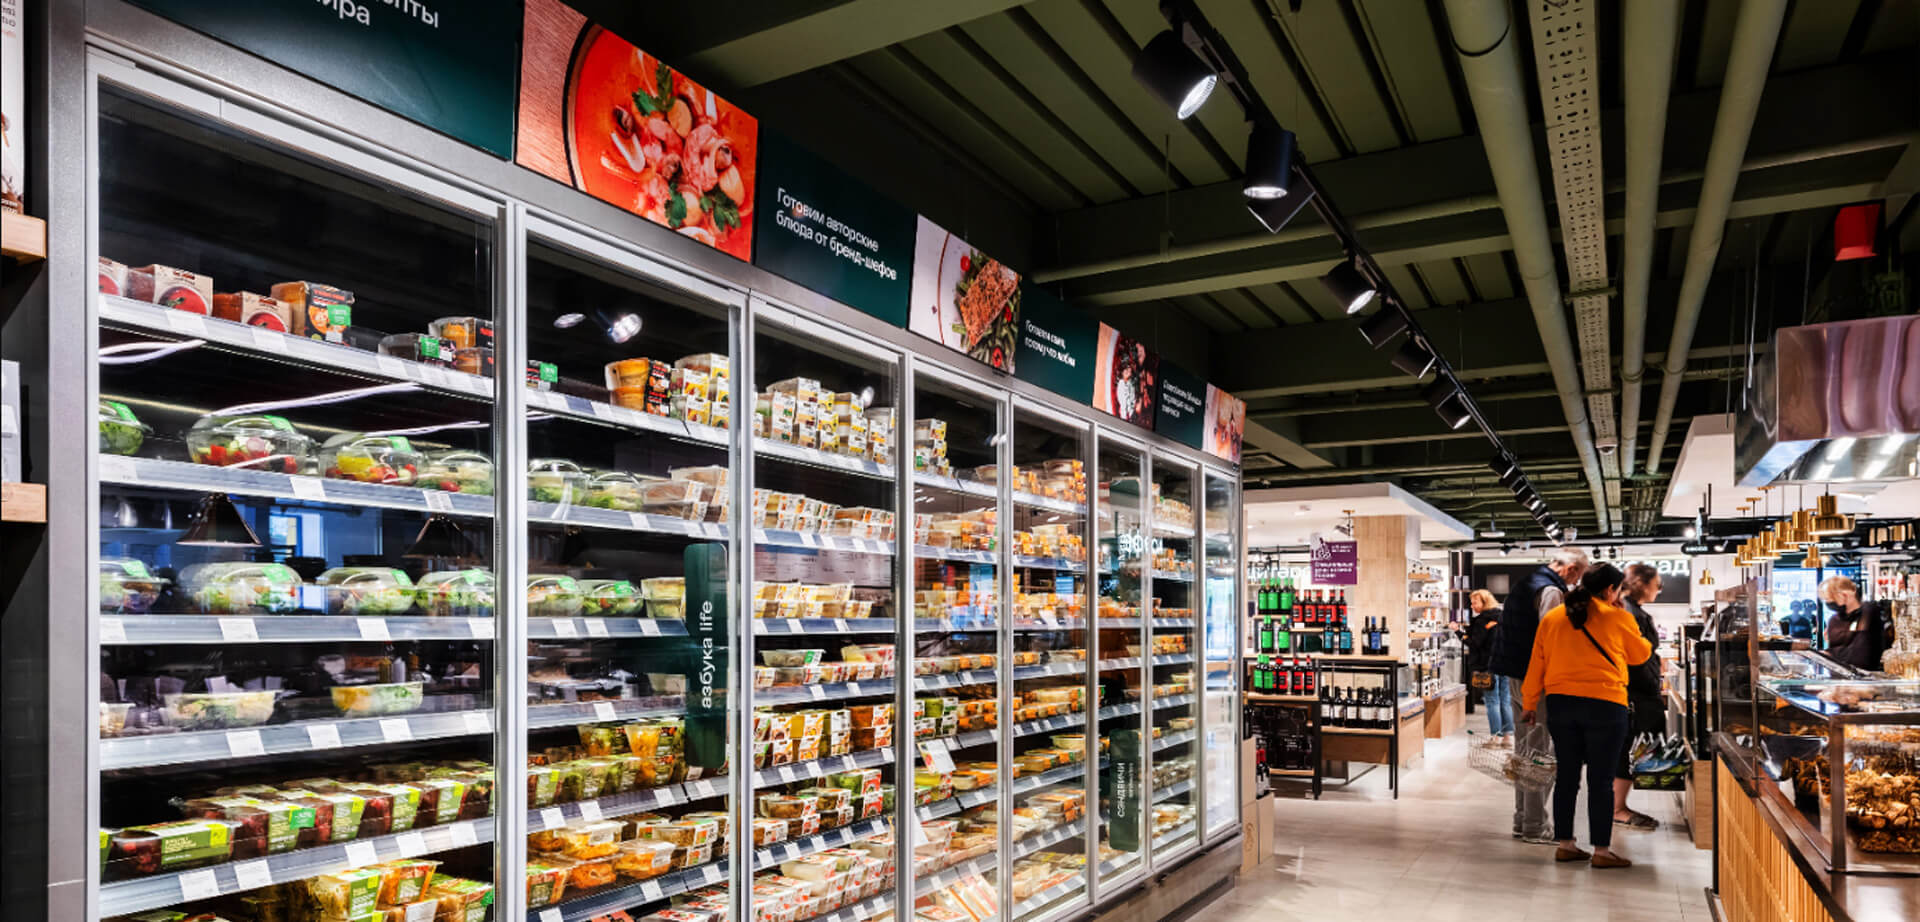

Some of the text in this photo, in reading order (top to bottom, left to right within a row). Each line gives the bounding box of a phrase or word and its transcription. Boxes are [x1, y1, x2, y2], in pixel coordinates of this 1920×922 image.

[776, 209, 897, 281] блюда от бренд-шефов
[777, 187, 879, 252] Готовим авторские
[698, 600, 716, 709] азбука life
